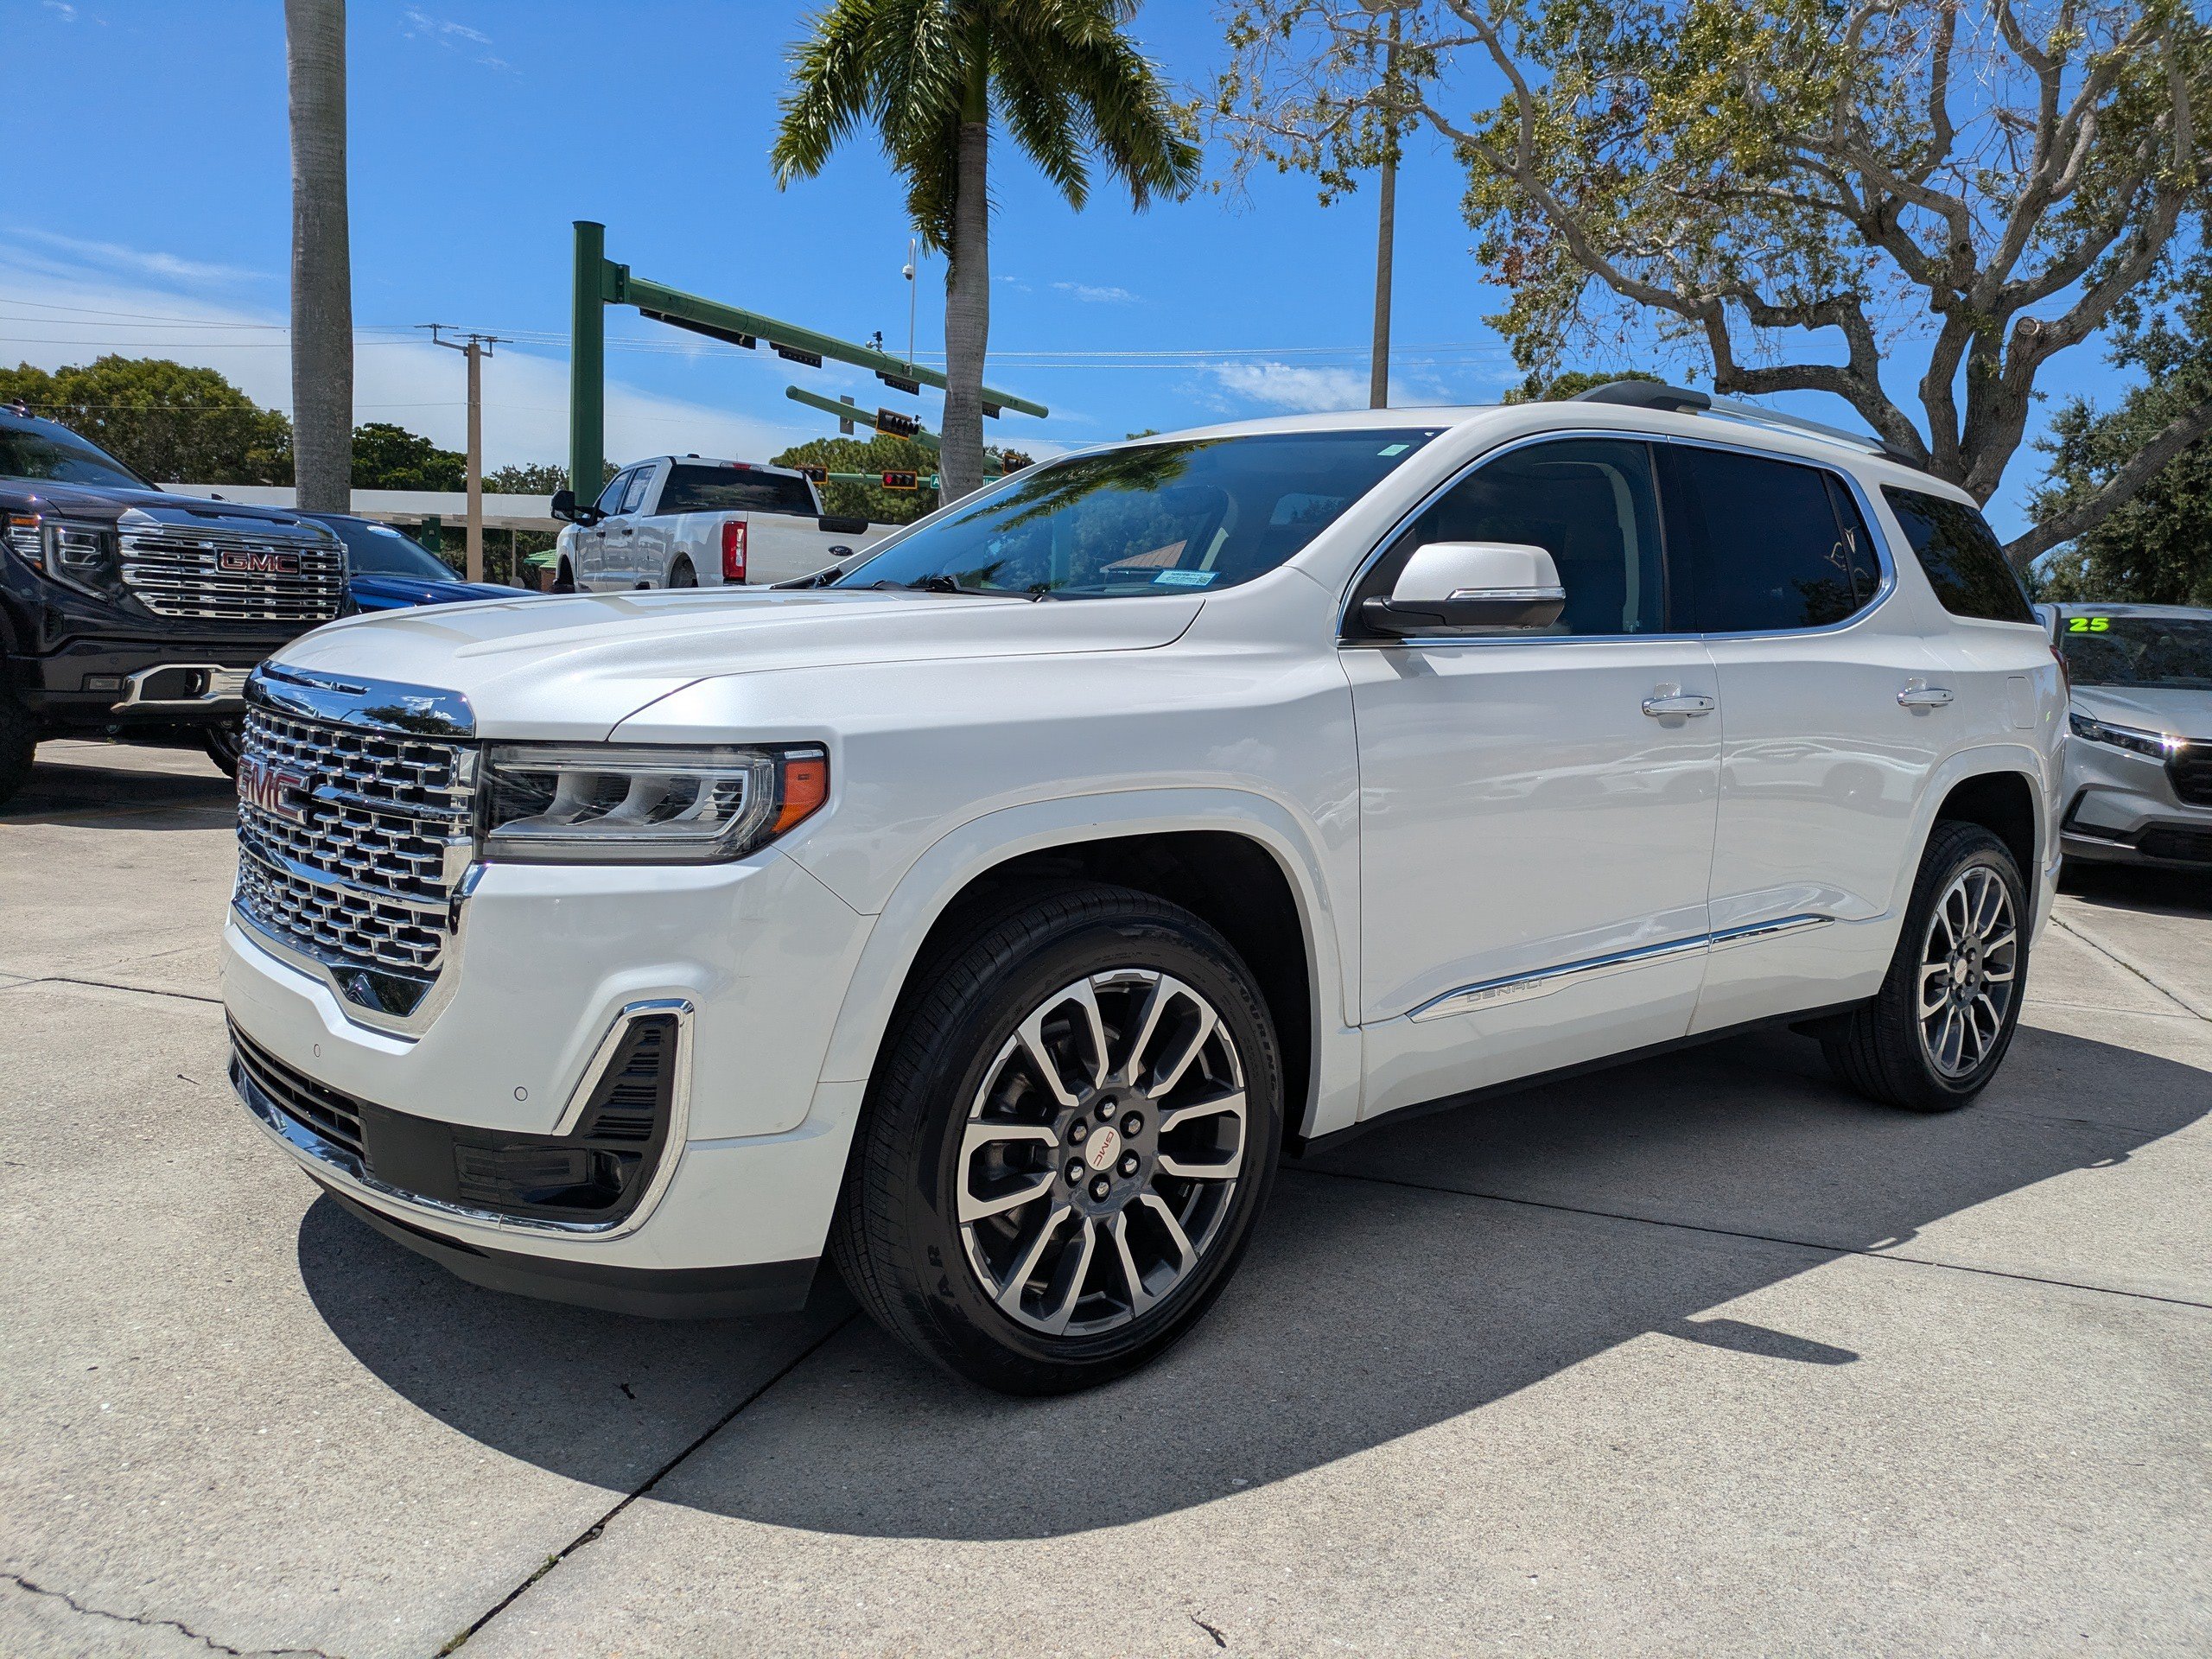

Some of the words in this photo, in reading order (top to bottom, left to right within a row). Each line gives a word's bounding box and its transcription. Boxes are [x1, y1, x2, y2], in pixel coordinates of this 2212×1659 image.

[220, 551, 298, 574] GMC
[2069, 618, 2109, 632] 25
[237, 755, 309, 825] GMC
[1466, 979, 1542, 1003] DENALI
[1093, 1131, 1115, 1166] GMC
